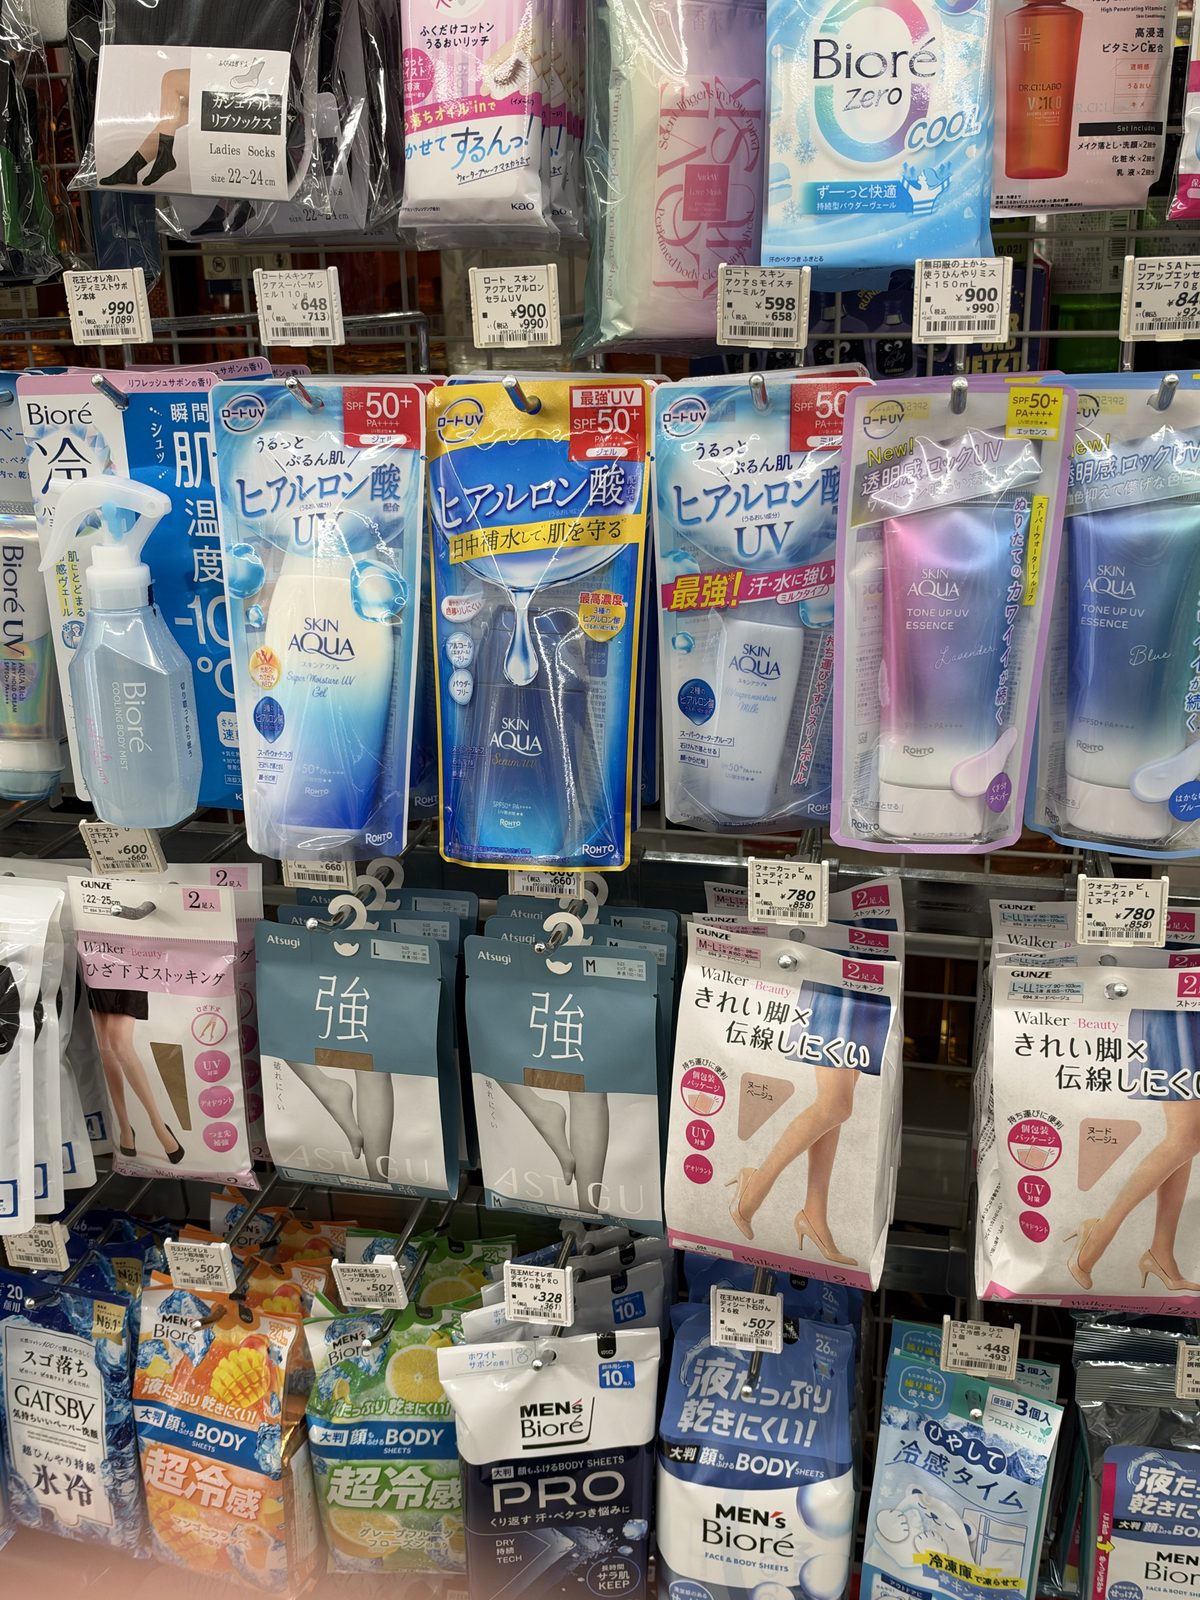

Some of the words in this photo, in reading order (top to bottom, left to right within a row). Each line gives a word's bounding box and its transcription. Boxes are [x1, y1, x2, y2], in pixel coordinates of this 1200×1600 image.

[420, 22, 495, 36] ふくだけコットン
[426, 36, 490, 49] うるおいリッチ
[812, 37, 937, 80] Bioré
[211, 113, 272, 130] リブソックス
[209, 143, 240, 155] Ladies
[248, 145, 276, 158] Socks
[211, 173, 225, 183] size
[816, 184, 897, 199] ずーっと快適
[924, 260, 987, 269] 無印服の上から
[483, 276, 505, 284] ロート
[514, 274, 537, 283] スキン
[725, 269, 750, 278] ロート
[759, 269, 785, 278] スキン
[924, 269, 996, 279] 使うひんやりミス
[483, 284, 545, 294] アクアヒアルロン
[725, 279, 794, 288] アクアSモイスチ
[75, 292, 96, 301] ン本体
[485, 294, 522, 303] セラムUV
[726, 288, 766, 297] ャーミルク
[955, 288, 998, 302] ¥900
[102, 301, 134, 316] ¥990
[293, 297, 327, 311] ¥648
[755, 296, 796, 310] ¥598
[510, 303, 547, 319] ¥900
[128, 377, 212, 388] リフレッシュサボンの香り
[1012, 393, 1058, 409] SPF50+
[27, 402, 93, 425] Bioré
[170, 403, 209, 423] 瞬間
[222, 408, 265, 419] ロートUV
[663, 411, 706, 422] ロートUV
[863, 414, 904, 426] ロートUV
[438, 415, 483, 427] ロートUV
[1016, 428, 1048, 436] エッセンス
[256, 437, 304, 453] うるっと
[867, 437, 915, 467] New!
[286, 450, 345, 466] ぷるん肌
[733, 454, 793, 474] ぷるん肌
[236, 463, 401, 519] ヒアルロン酸
[438, 464, 625, 529] ヒアルロン酸
[383, 504, 400, 513] 配合
[734, 521, 794, 559] UV
[921, 568, 949, 578] SKIN
[1097, 565, 1126, 576] SKIN
[907, 580, 960, 601] AQUA
[1083, 577, 1136, 599] AQUA
[579, 592, 623, 606] 最高濃度
[906, 609, 936, 617] TONE
[938, 609, 952, 617] UP
[954, 608, 969, 617] UV
[1081, 604, 1110, 615] TONE
[1112, 607, 1127, 615] UP
[1129, 608, 1145, 617] UV
[304, 618, 339, 632] SKIN
[906, 621, 954, 631] ESSENCE
[1081, 617, 1128, 629] ESSENCE
[2, 620, 25, 657] UV
[288, 632, 356, 662] AQUA
[743, 643, 771, 657] SKIN
[1129, 645, 1175, 666] Blue
[729, 656, 781, 680] AQUA
[123, 681, 152, 753] Bioré
[502, 717, 530, 731] SKIN
[490, 732, 543, 756] AQUA
[1077, 740, 1104, 753] ROHTO
[903, 746, 934, 757] ROHTO
[852, 818, 880, 833] ROHTO
[365, 831, 393, 846] ROHTO
[582, 843, 615, 858] ROHTO
[755, 865, 791, 873] ウォーカー
[81, 880, 112, 890] GUNZE
[780, 889, 816, 901] ¥780
[853, 909, 890, 918] ストッキング
[999, 903, 1036, 911] GUNZE
[1115, 907, 1155, 920] ¥780
[702, 915, 738, 924] GUNZE
[267, 934, 301, 948] Atsugi
[500, 932, 536, 945] Atsugi
[696, 927, 731, 941] GUNZE
[1008, 933, 1057, 949] Walker
[83, 940, 125, 955] Walker
[373, 942, 380, 956] L
[478, 951, 512, 965] Atsugi
[585, 958, 596, 973] M
[848, 962, 879, 981] 2足入
[86, 962, 226, 986] ひざ下丈ストッキング
[701, 966, 749, 987] Walker
[1011, 970, 1052, 978] GUNZE
[842, 980, 884, 993] ストッキング
[314, 974, 371, 1043] 強
[1014, 1011, 1070, 1027] Walker
[529, 991, 585, 1062] 強
[725, 1021, 869, 1067] 伝線しにくい
[203, 1059, 221, 1070] UV
[682, 1057, 728, 1081] 持ち運びに便利
[692, 1071, 716, 1082] 個包装
[687, 1080, 720, 1093] パッケージ
[748, 1081, 768, 1090] ヌード
[746, 1090, 773, 1101] ベージュ
[1007, 1109, 1065, 1130] 持ち運びに便利
[692, 1127, 709, 1138] UV
[1021, 1123, 1049, 1135] 個包装
[1088, 1126, 1112, 1135] ヌード
[1015, 1134, 1056, 1145] パッケージ
[1086, 1135, 1118, 1145] ベージュ
[1023, 1182, 1045, 1195] UV
[195, 1264, 221, 1273] ¥507
[366, 1284, 394, 1292] ¥507
[533, 1291, 562, 1303] ¥328
[743, 1318, 775, 1330] ¥507
[468, 1351, 497, 1360] ホワイト
[22, 1350, 88, 1377] スゴ落ち
[14, 1385, 95, 1424] GATSBY
[1014, 1398, 1051, 1426] 3個入
[521, 1414, 584, 1438] Bioré
[678, 1399, 817, 1448] 乾きにくい!
[320, 1431, 343, 1443] 大判
[192, 1440, 216, 1453] SHEETS
[929, 1424, 1003, 1470] ひやして
[587, 1455, 625, 1468] SHEETS
[670, 1447, 697, 1461] 大判
[794, 1467, 825, 1479] SHEETS
[893, 1439, 1024, 1510] 冷感タイム
[32, 1464, 93, 1507] 氷冷
[146, 1448, 262, 1520] 超冷感
[493, 1471, 625, 1513] PRO
[490, 1515, 532, 1527] くり返す
[715, 1503, 787, 1529] MEN's
[496, 1539, 515, 1547] DRY
[702, 1518, 794, 1558] Bioré
[496, 1555, 522, 1564] TECH
[704, 1551, 724, 1563] FACE
[734, 1558, 757, 1567] BODY
[759, 1562, 789, 1573] SHEETS
[598, 1571, 630, 1580] サラ肌
[599, 1581, 630, 1590] KEEP
